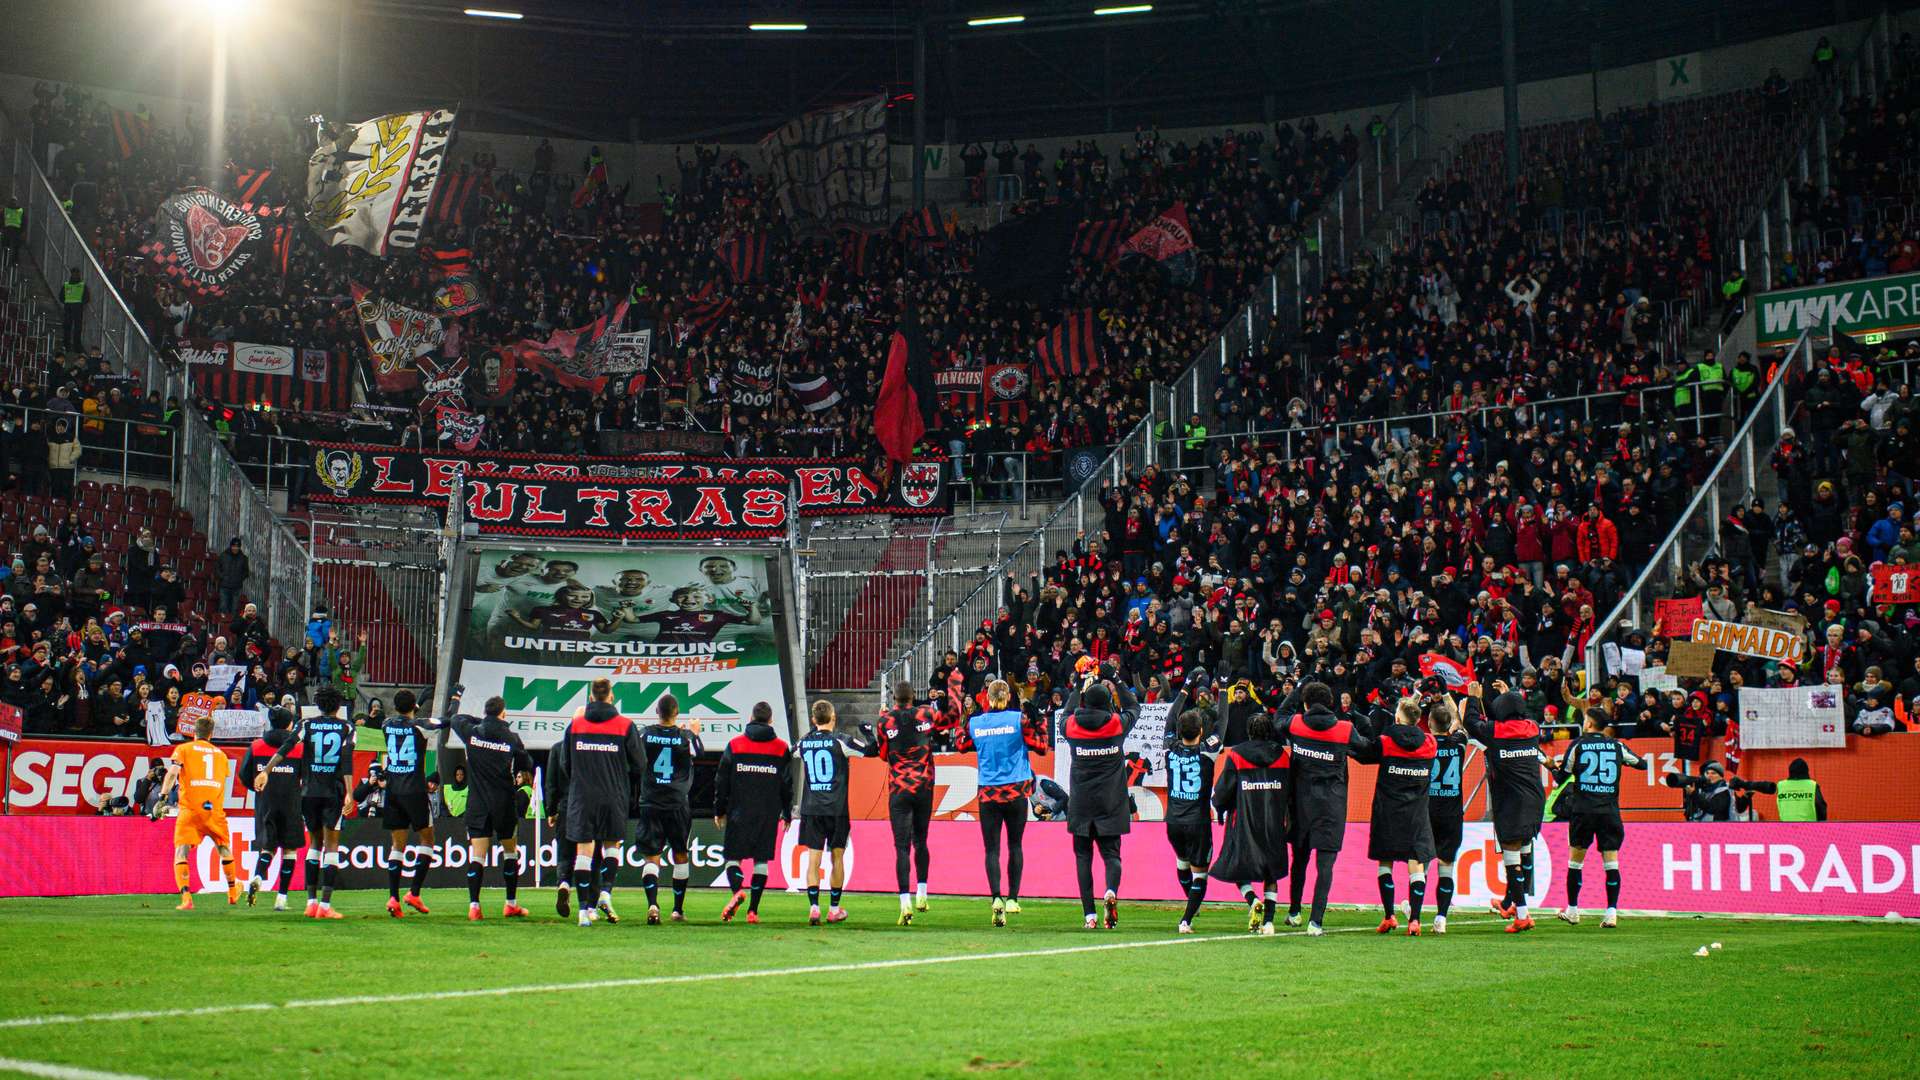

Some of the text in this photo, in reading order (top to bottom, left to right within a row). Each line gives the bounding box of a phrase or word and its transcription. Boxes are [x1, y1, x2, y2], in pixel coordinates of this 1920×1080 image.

[1764, 291, 1856, 334] WWK
[465, 480, 788, 529] ULTRAS
[504, 636, 745, 655] UNTERSTÜTZUNG.
[1692, 618, 1804, 662] GRIMALDO
[503, 676, 739, 714] WWK
[470, 736, 511, 753] Barmenia
[974, 725, 1015, 738] Barmenia
[311, 731, 342, 764] 12
[387, 734, 418, 766] 44
[575, 740, 619, 753] Barmenia
[1075, 744, 1119, 757] Barmenia
[1292, 743, 1335, 761] Barmenia
[202, 753, 213, 780] 1
[653, 747, 674, 779] 4
[736, 762, 777, 775] Barmenia
[803, 749, 834, 783] 10
[1169, 760, 1202, 793] 13
[1388, 764, 1429, 777] Barmenia
[1430, 756, 1461, 790] 24
[1579, 751, 1617, 784] 25
[1241, 780, 1282, 791] Barmenia
[1580, 784, 1615, 794] PALACIOS
